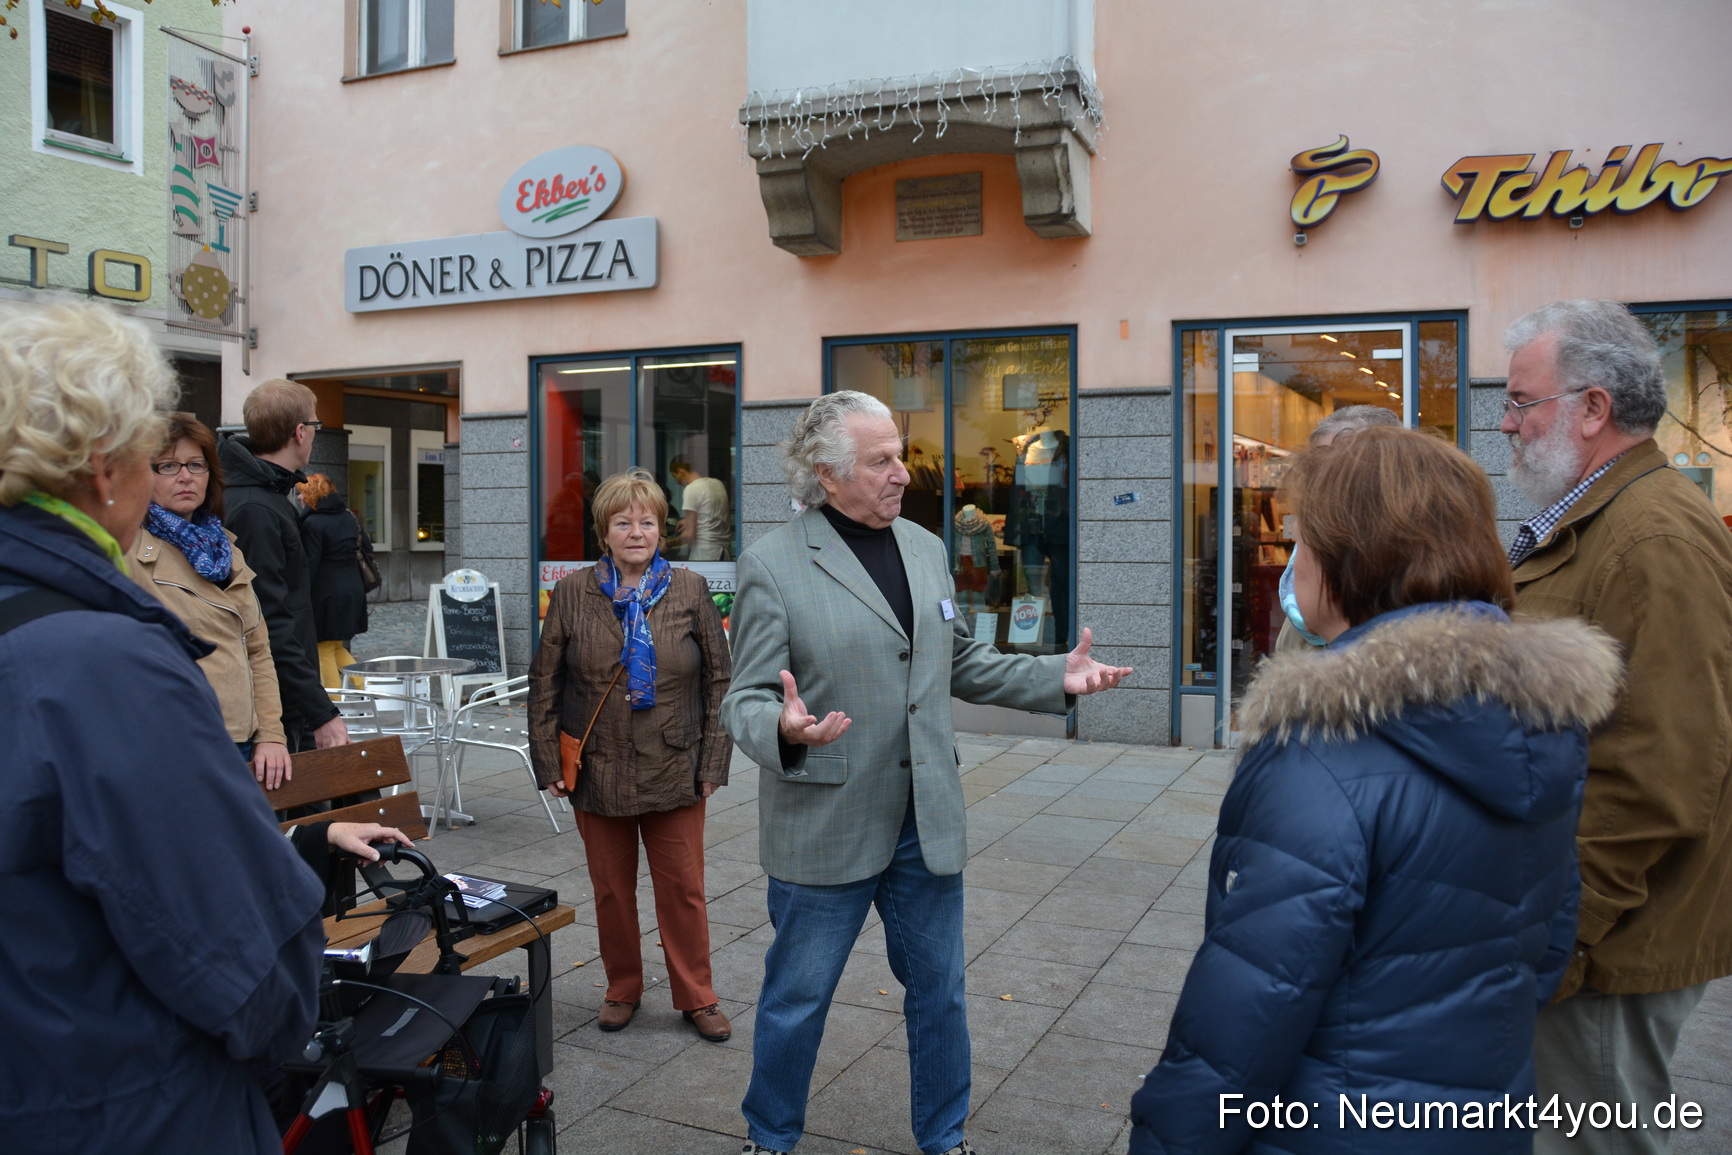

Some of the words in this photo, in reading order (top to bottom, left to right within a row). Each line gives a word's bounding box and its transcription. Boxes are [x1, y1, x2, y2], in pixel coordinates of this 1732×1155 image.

[516, 165, 606, 213] Ekber's
[1441, 143, 1732, 224] Tchibo
[359, 252, 479, 301] DÖNER
[489, 258, 512, 288] &
[525, 239, 635, 286] PIZZA
[984, 343, 1006, 354] Ihren
[1007, 341, 1039, 352] Genuss
[1014, 606, 1039, 621] 10%
